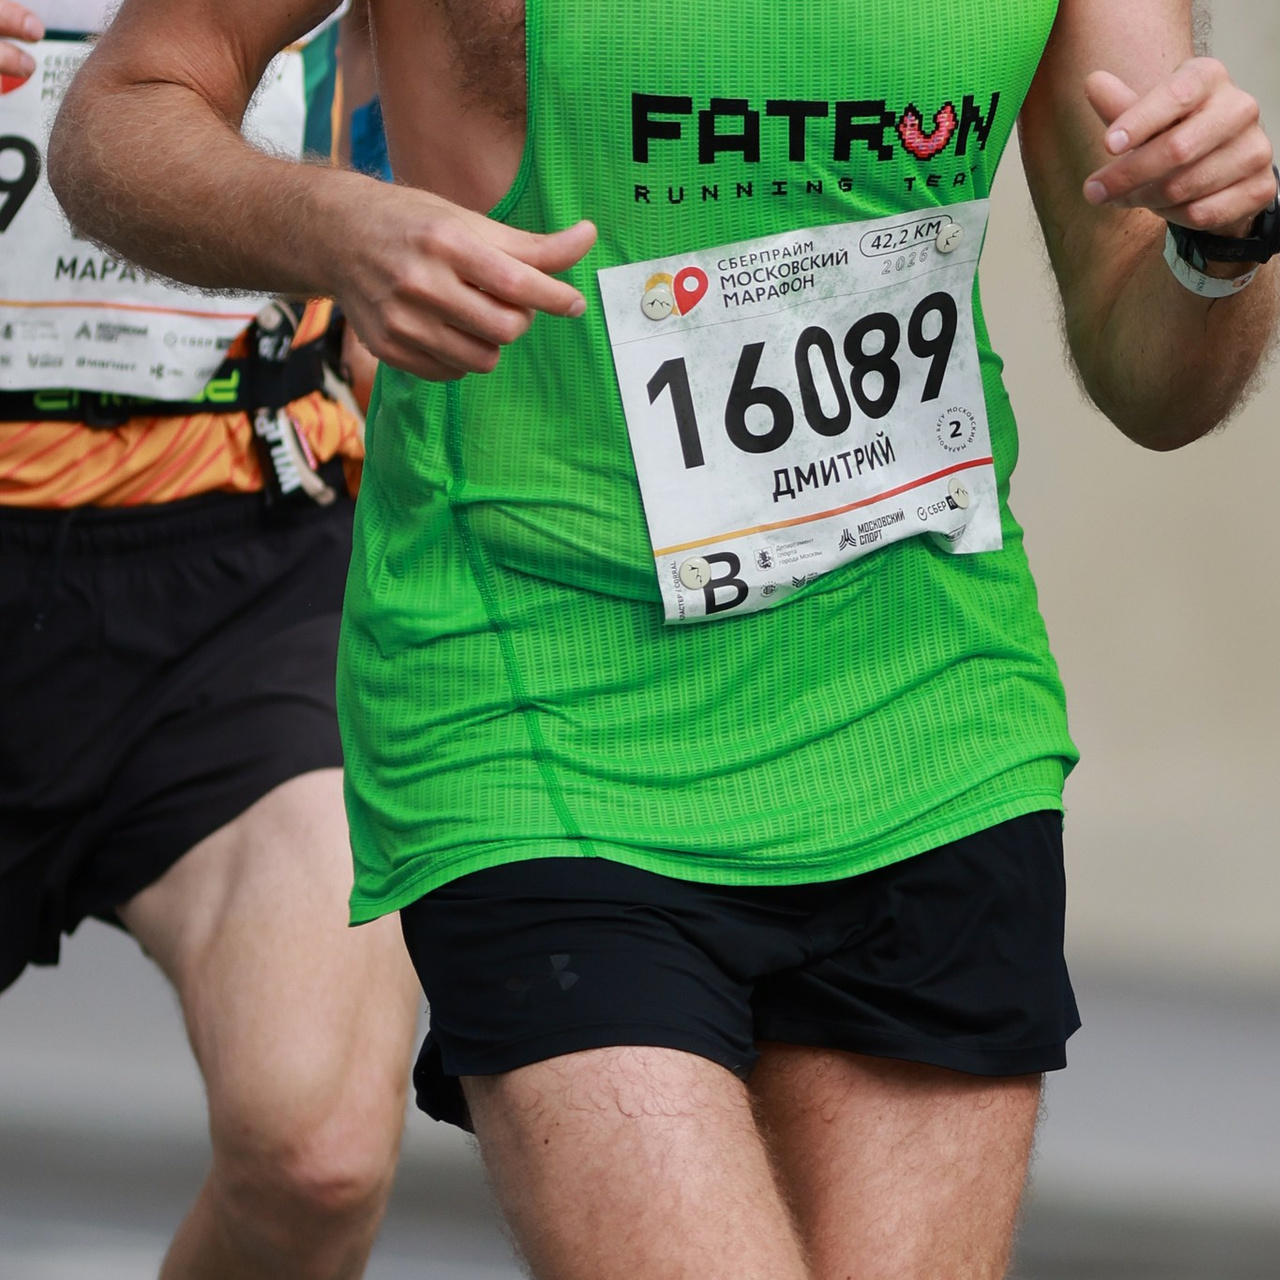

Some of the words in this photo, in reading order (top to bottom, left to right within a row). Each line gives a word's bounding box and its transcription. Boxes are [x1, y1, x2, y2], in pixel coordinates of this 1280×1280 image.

[632, 92, 1000, 163] FATRUN
[634, 178, 854, 204] RUNNING
[904, 165, 977, 191] TEA
[870, 228, 908, 251] 42,2
[55, 256, 151, 282] МАРА
[717, 241, 814, 271] СБЕРПРАЙМ
[720, 248, 848, 290] МОСКОВСКИЙ
[723, 274, 815, 308] МАРАФОН
[646, 292, 958, 469] 16089
[949, 420, 962, 438] 2
[772, 431, 896, 502] ДМИТРИЙ
[857, 508, 905, 534] МОСКОВСКИЙ
[927, 500, 947, 516] СБЕР
[859, 529, 883, 546] СПОРТ
